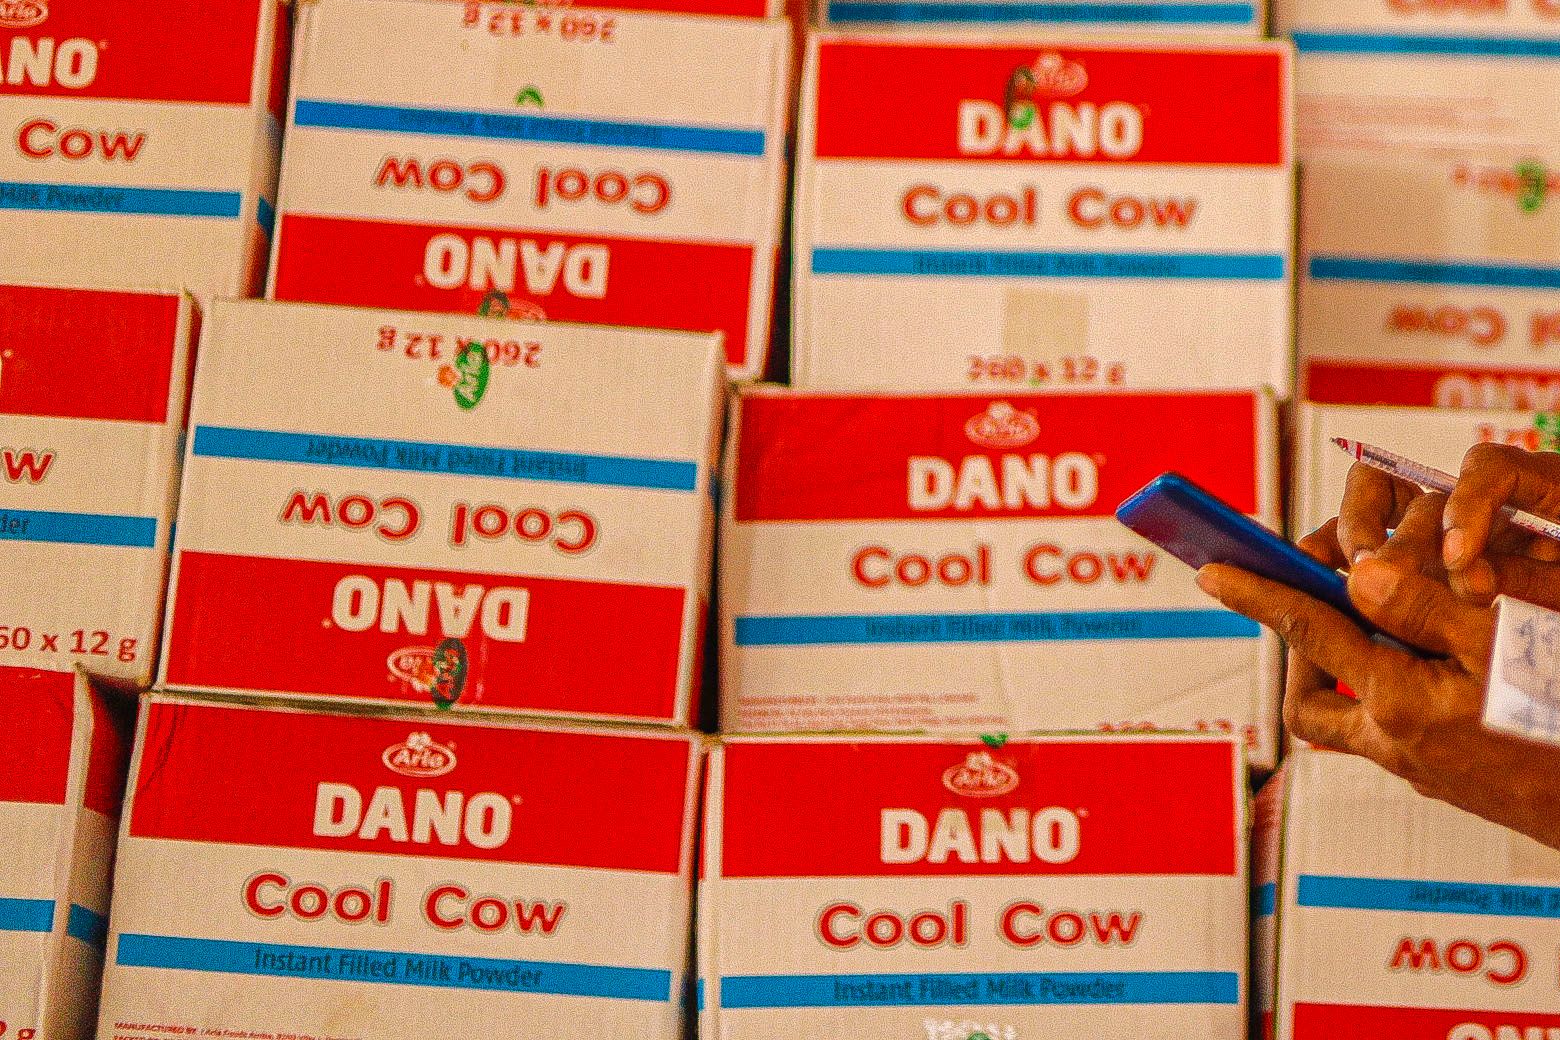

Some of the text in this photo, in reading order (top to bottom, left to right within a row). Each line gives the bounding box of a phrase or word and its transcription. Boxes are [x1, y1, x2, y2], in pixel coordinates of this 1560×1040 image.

[0, 36, 100, 89] NO
[17, 119, 145, 161] Cow
[959, 101, 1142, 157] DANO
[376, 157, 672, 214] Cool Cow
[900, 185, 1196, 230] Cool Cow
[424, 234, 609, 298] DANO
[377, 327, 397, 350] g
[404, 334, 442, 360] 12
[482, 340, 541, 368] 260
[908, 453, 1098, 510] DANO
[282, 492, 597, 554] Cool Cow
[850, 543, 1156, 589] Cool Cow
[332, 575, 530, 642] DANO
[0, 626, 32, 651] 60
[71, 629, 110, 656] 12
[117, 638, 138, 664] g
[313, 782, 512, 849] DANO
[880, 806, 1080, 863] DANO
[245, 872, 565, 934] Cool Cow
[818, 902, 1141, 948] Cool Cow
[253, 948, 543, 989] Instant Filled Milk Powder
[1390, 938, 1529, 986] Cow
[833, 979, 910, 1002] Instant
